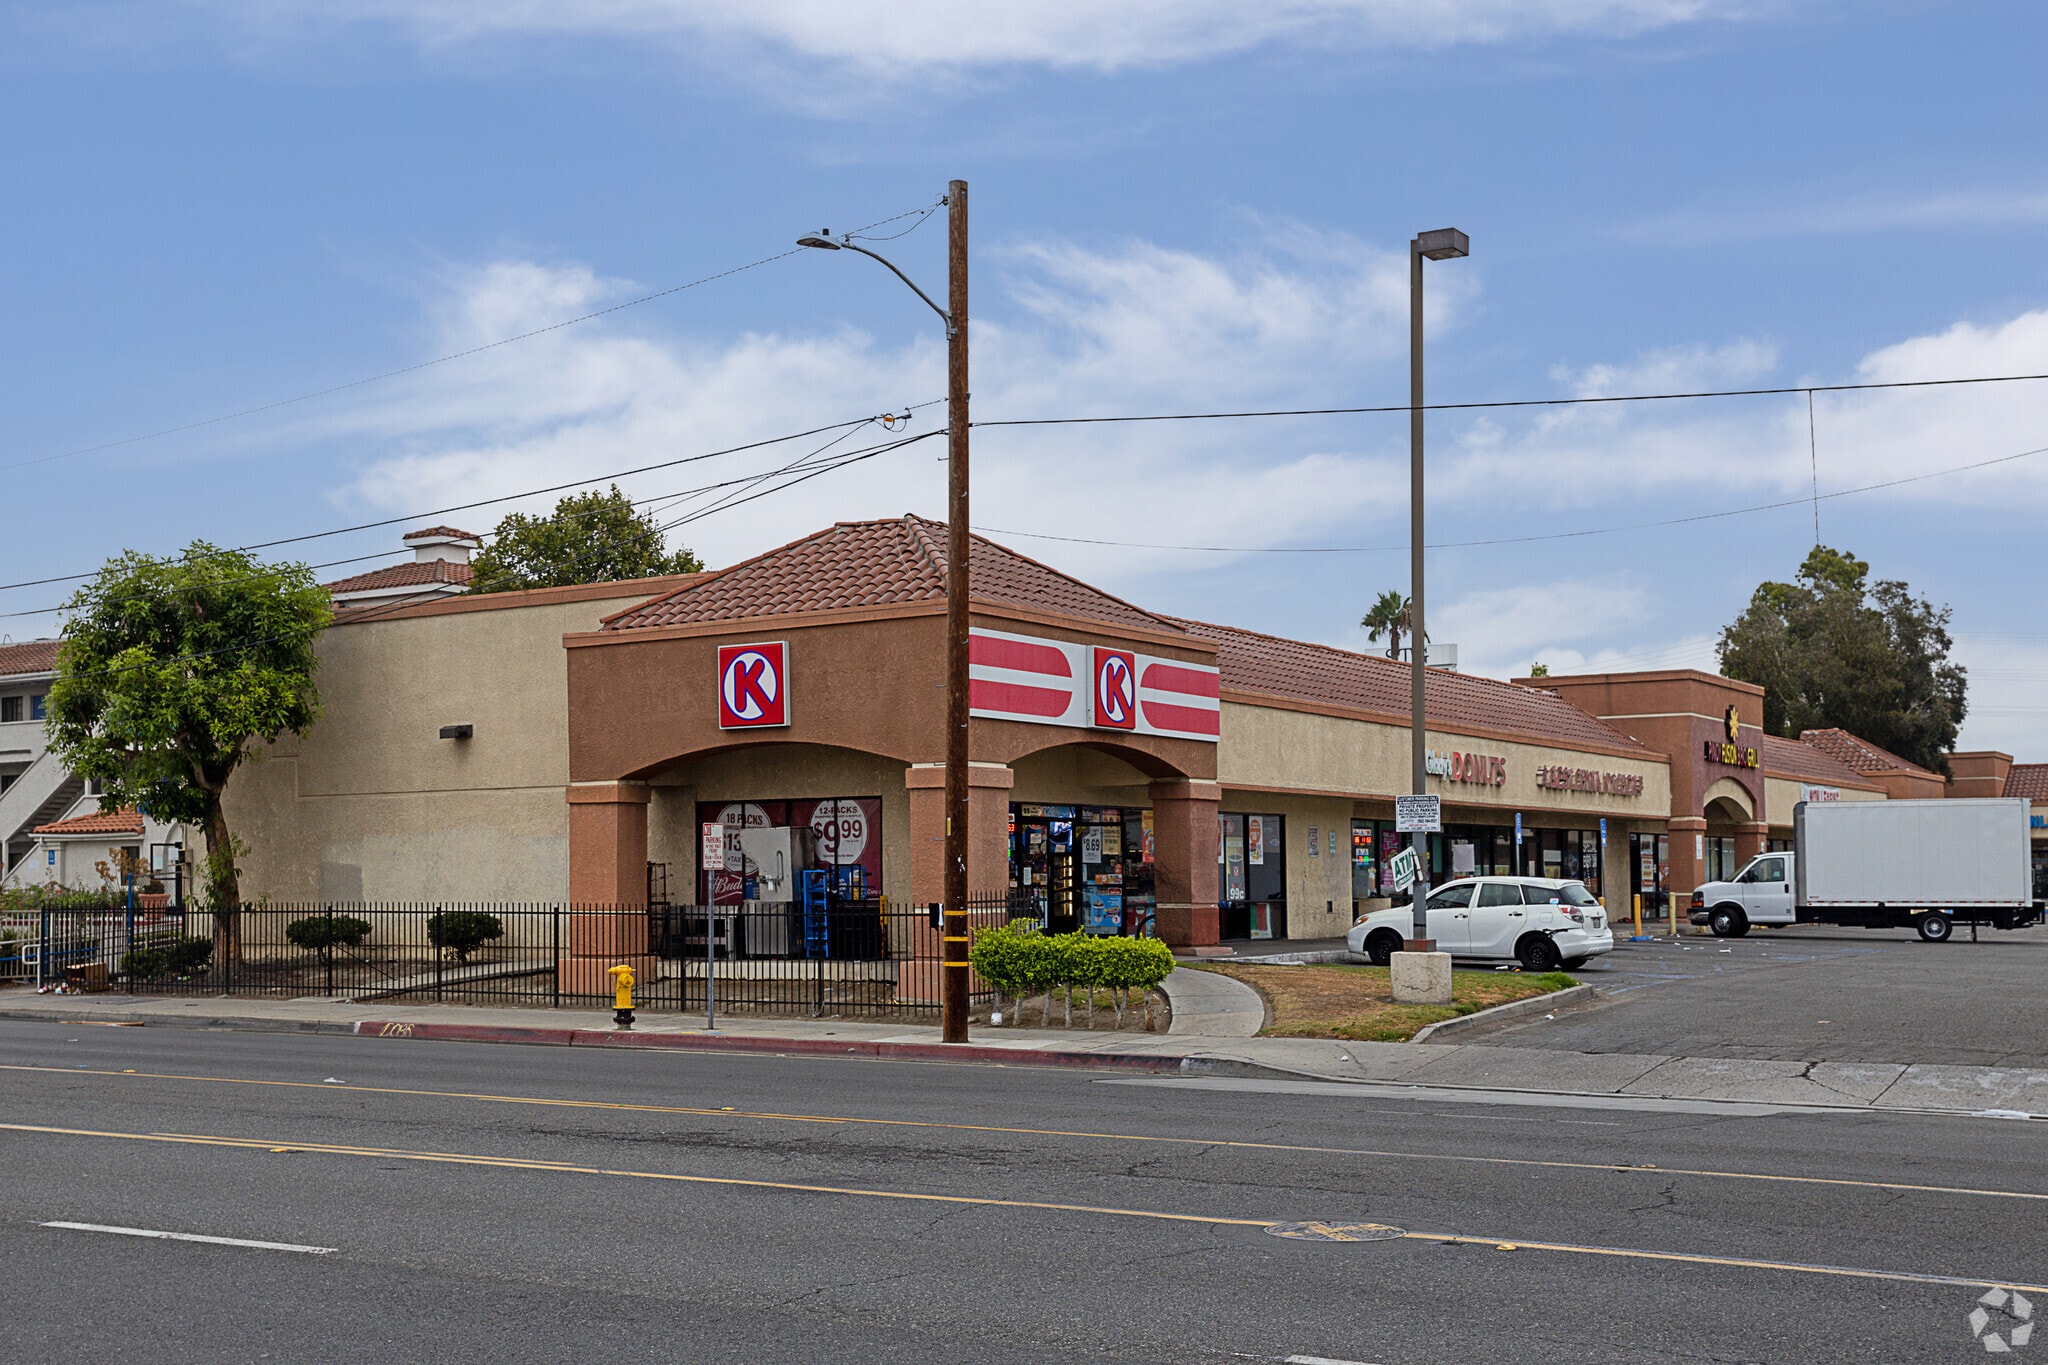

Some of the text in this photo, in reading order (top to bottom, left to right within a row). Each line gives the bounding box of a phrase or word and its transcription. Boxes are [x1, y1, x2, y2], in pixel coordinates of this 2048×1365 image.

[1453, 751, 1507, 786] DONUTS
[727, 813, 735, 823] 18
[1083, 838, 1100, 851] $8.69
[1394, 851, 1413, 879] ATM
